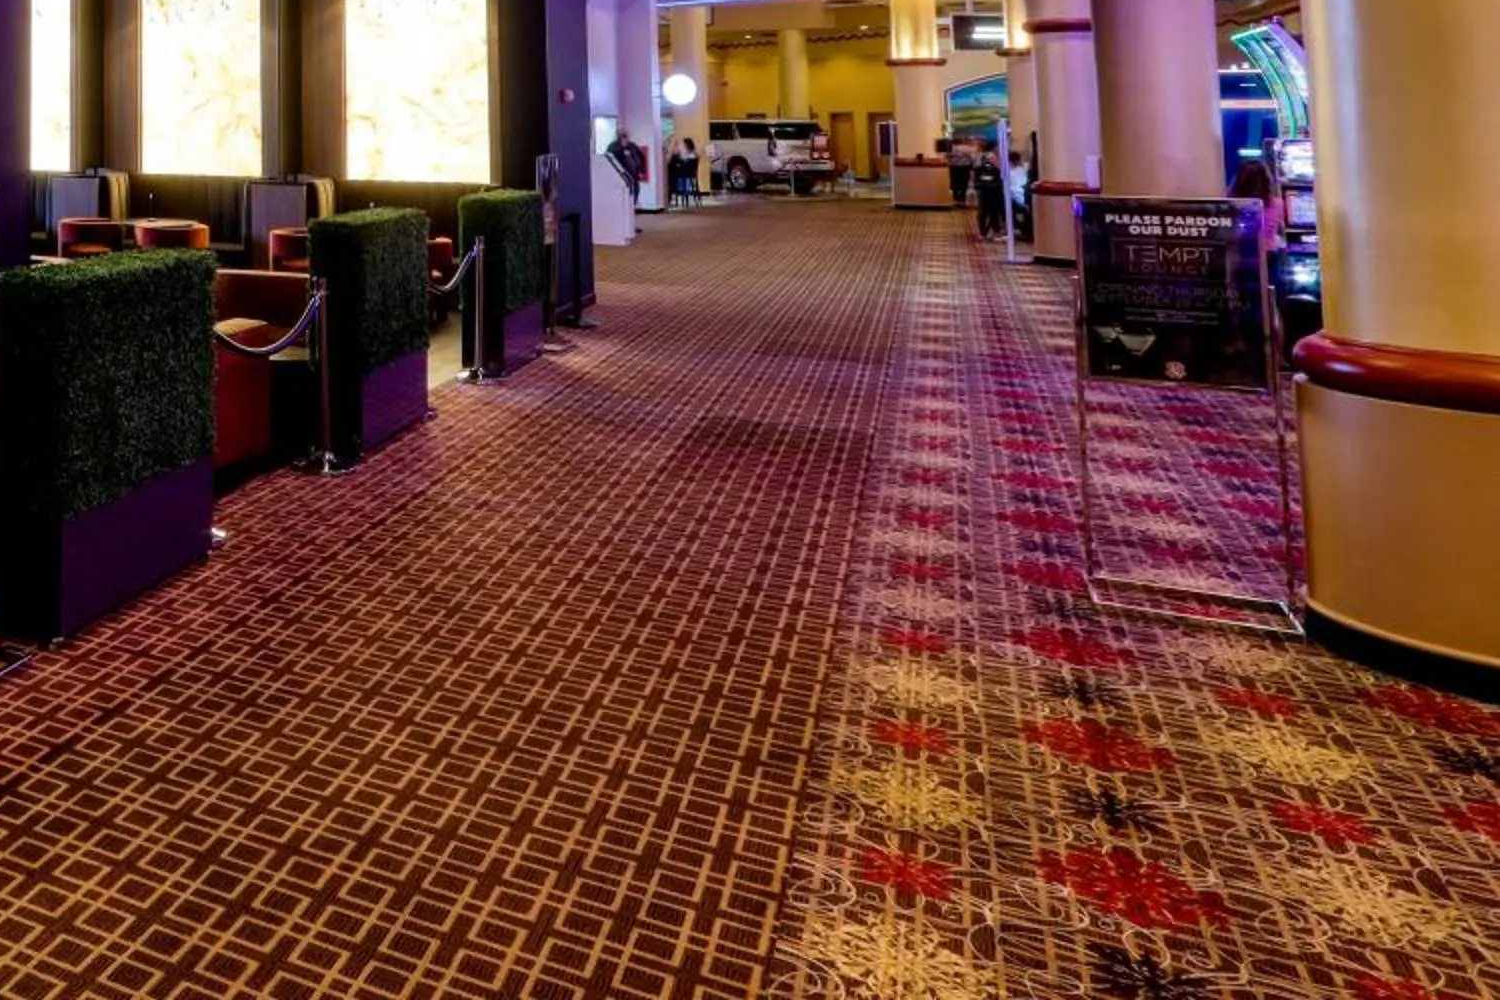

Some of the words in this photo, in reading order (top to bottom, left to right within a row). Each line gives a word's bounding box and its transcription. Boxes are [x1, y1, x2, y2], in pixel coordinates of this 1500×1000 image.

[1104, 213, 1161, 226] PLEASE
[1164, 214, 1233, 228] PARDON
[1128, 225, 1163, 236] OUR
[1167, 227, 1210, 238] DUST
[1124, 244, 1215, 264] TEMPT
[1128, 262, 1210, 276] LOUNGE
